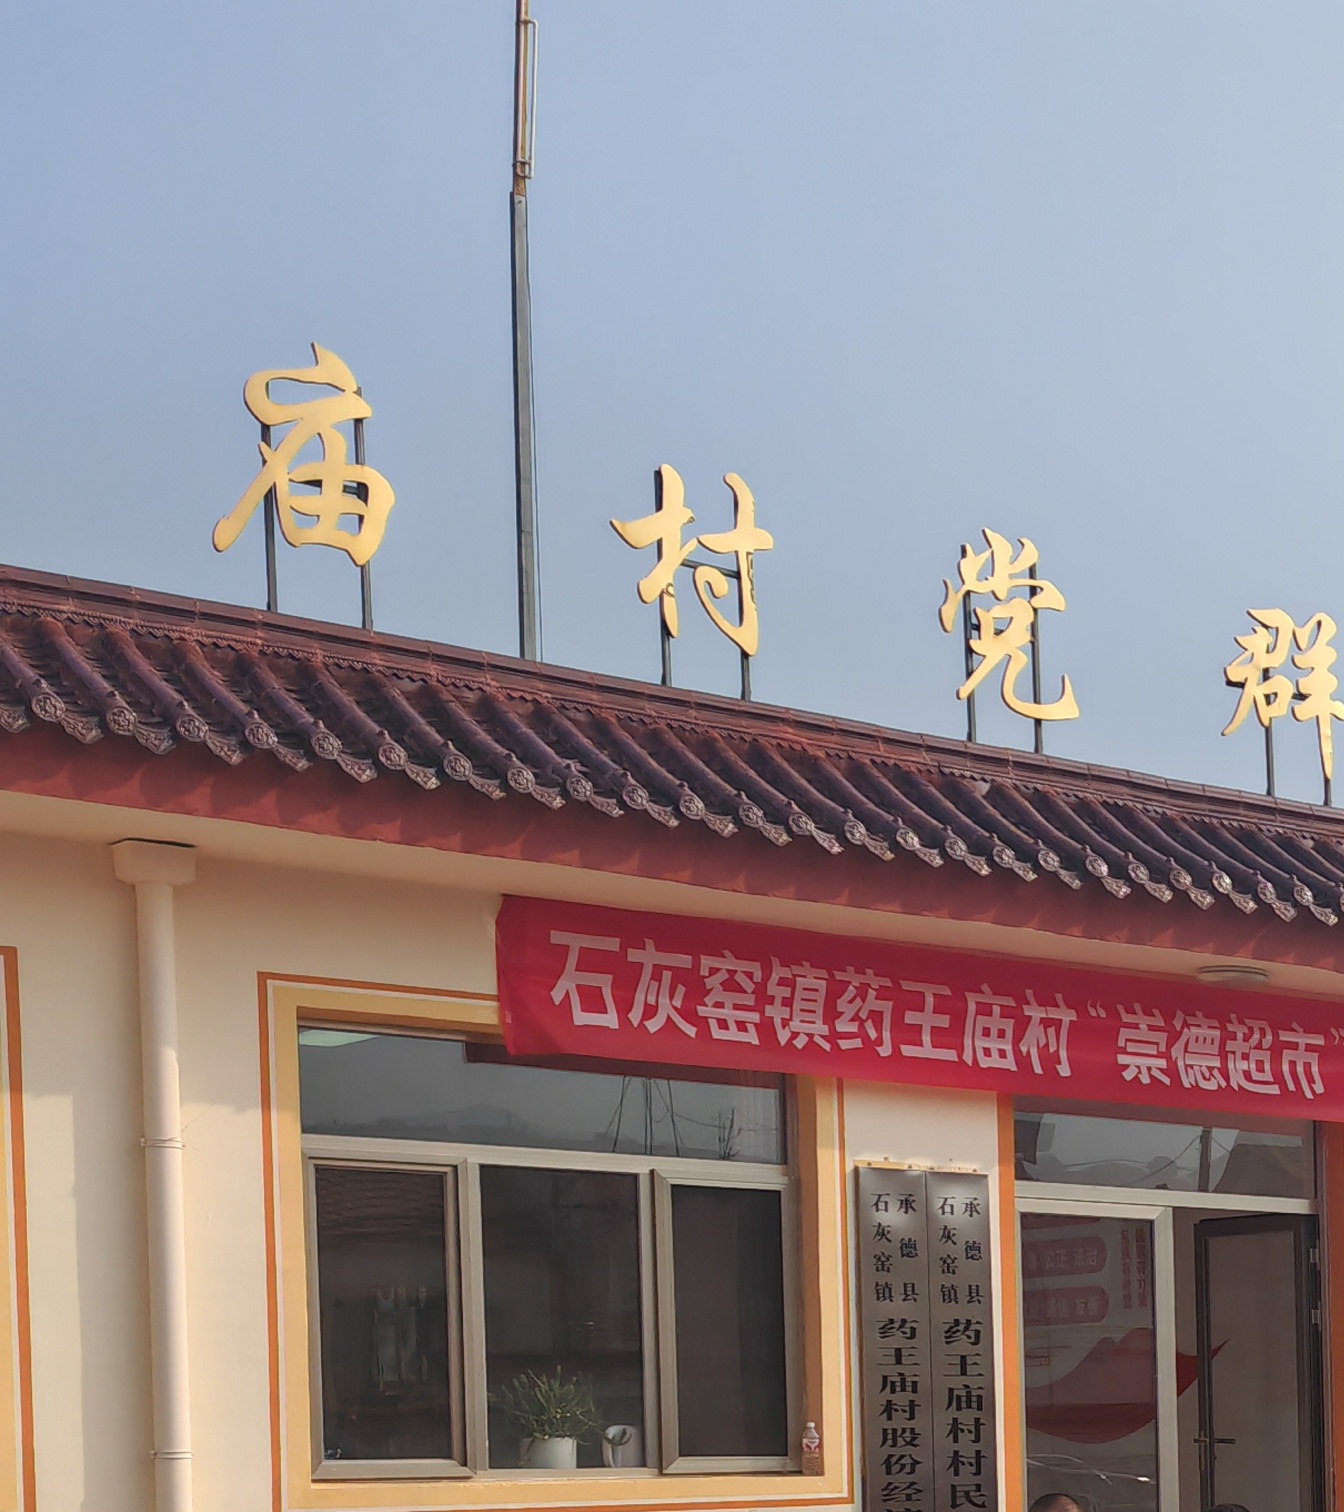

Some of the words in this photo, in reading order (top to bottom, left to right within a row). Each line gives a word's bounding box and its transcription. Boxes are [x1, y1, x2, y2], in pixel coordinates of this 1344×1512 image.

[871, 1193, 894, 1303] 石灰窑镇
[896, 1192, 919, 1303] 承德县
[937, 1195, 959, 1304] 石灰窑镇
[961, 1196, 984, 1304] 承德县
